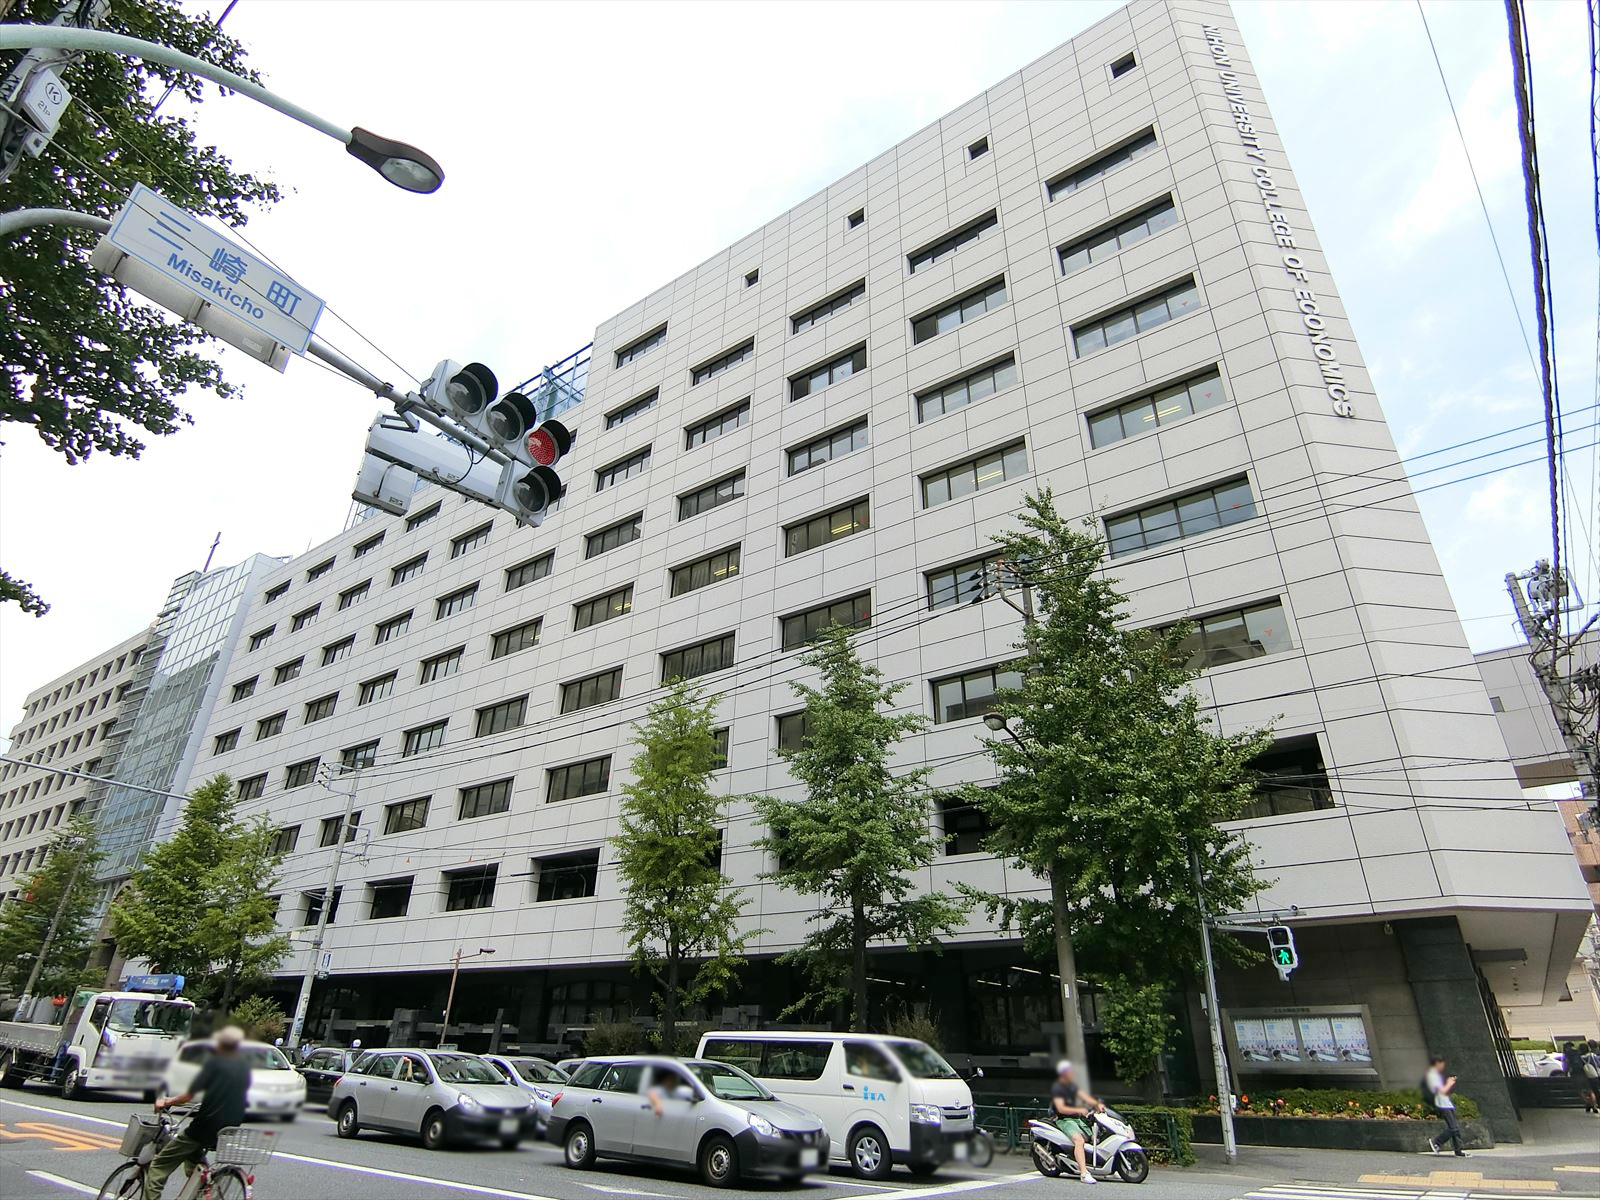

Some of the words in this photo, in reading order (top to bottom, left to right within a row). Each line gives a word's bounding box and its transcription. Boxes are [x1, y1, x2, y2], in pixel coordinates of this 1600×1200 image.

[1202, 23, 1232, 68] NIHON
[1219, 70, 1266, 163] UNIVERSITY
[1251, 165, 1297, 250] COLLEGE
[148, 210, 302, 317] 三崎町
[167, 252, 264, 320] Misakicho
[1282, 255, 1309, 283] OF
[1293, 287, 1356, 419] ECONOMICS
